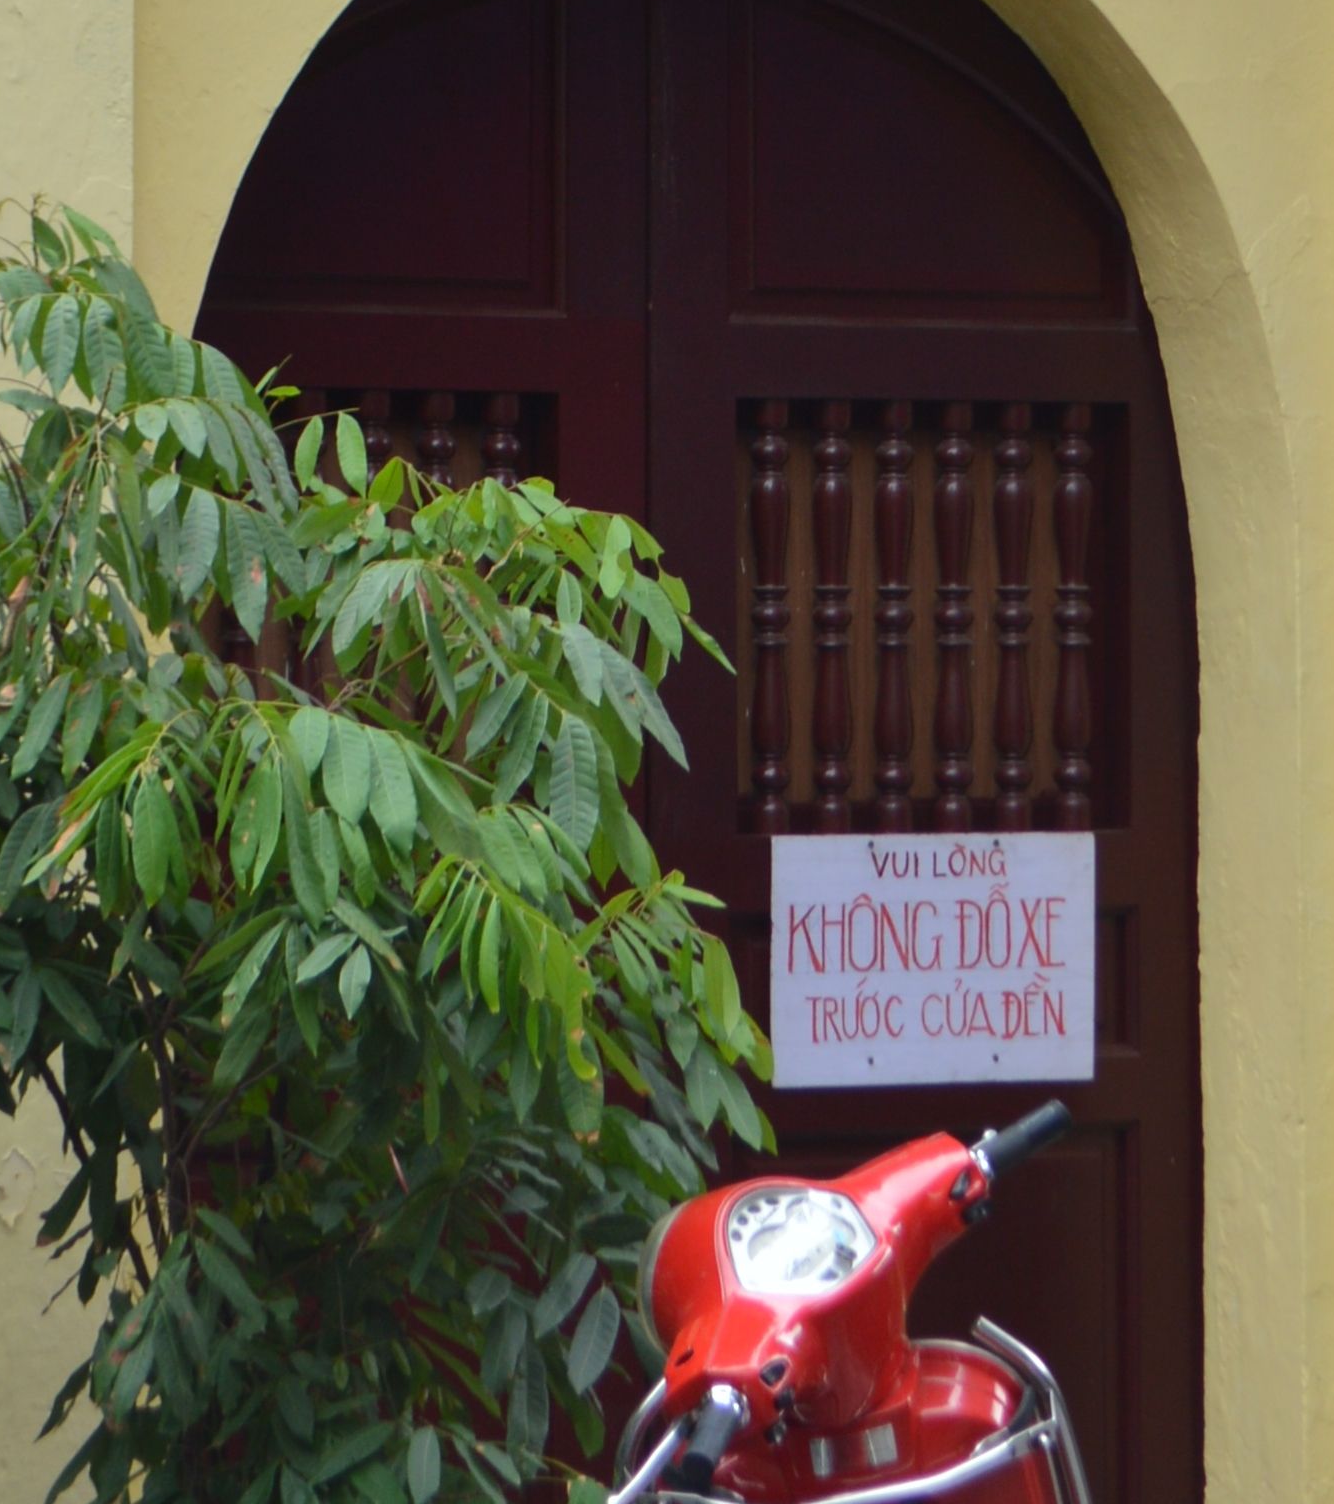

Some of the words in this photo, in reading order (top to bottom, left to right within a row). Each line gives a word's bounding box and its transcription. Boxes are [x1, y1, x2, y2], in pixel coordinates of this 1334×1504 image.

[870, 851, 920, 878] VUI
[932, 843, 1007, 878] LÒNG
[787, 892, 942, 974] KHÔNG
[954, 881, 1012, 970] ĐỖ
[1017, 897, 1066, 969] XE
[804, 977, 904, 1044] TRƯỚC
[920, 978, 997, 1038] CỬA
[1001, 972, 1067, 1041] ĐỀN
